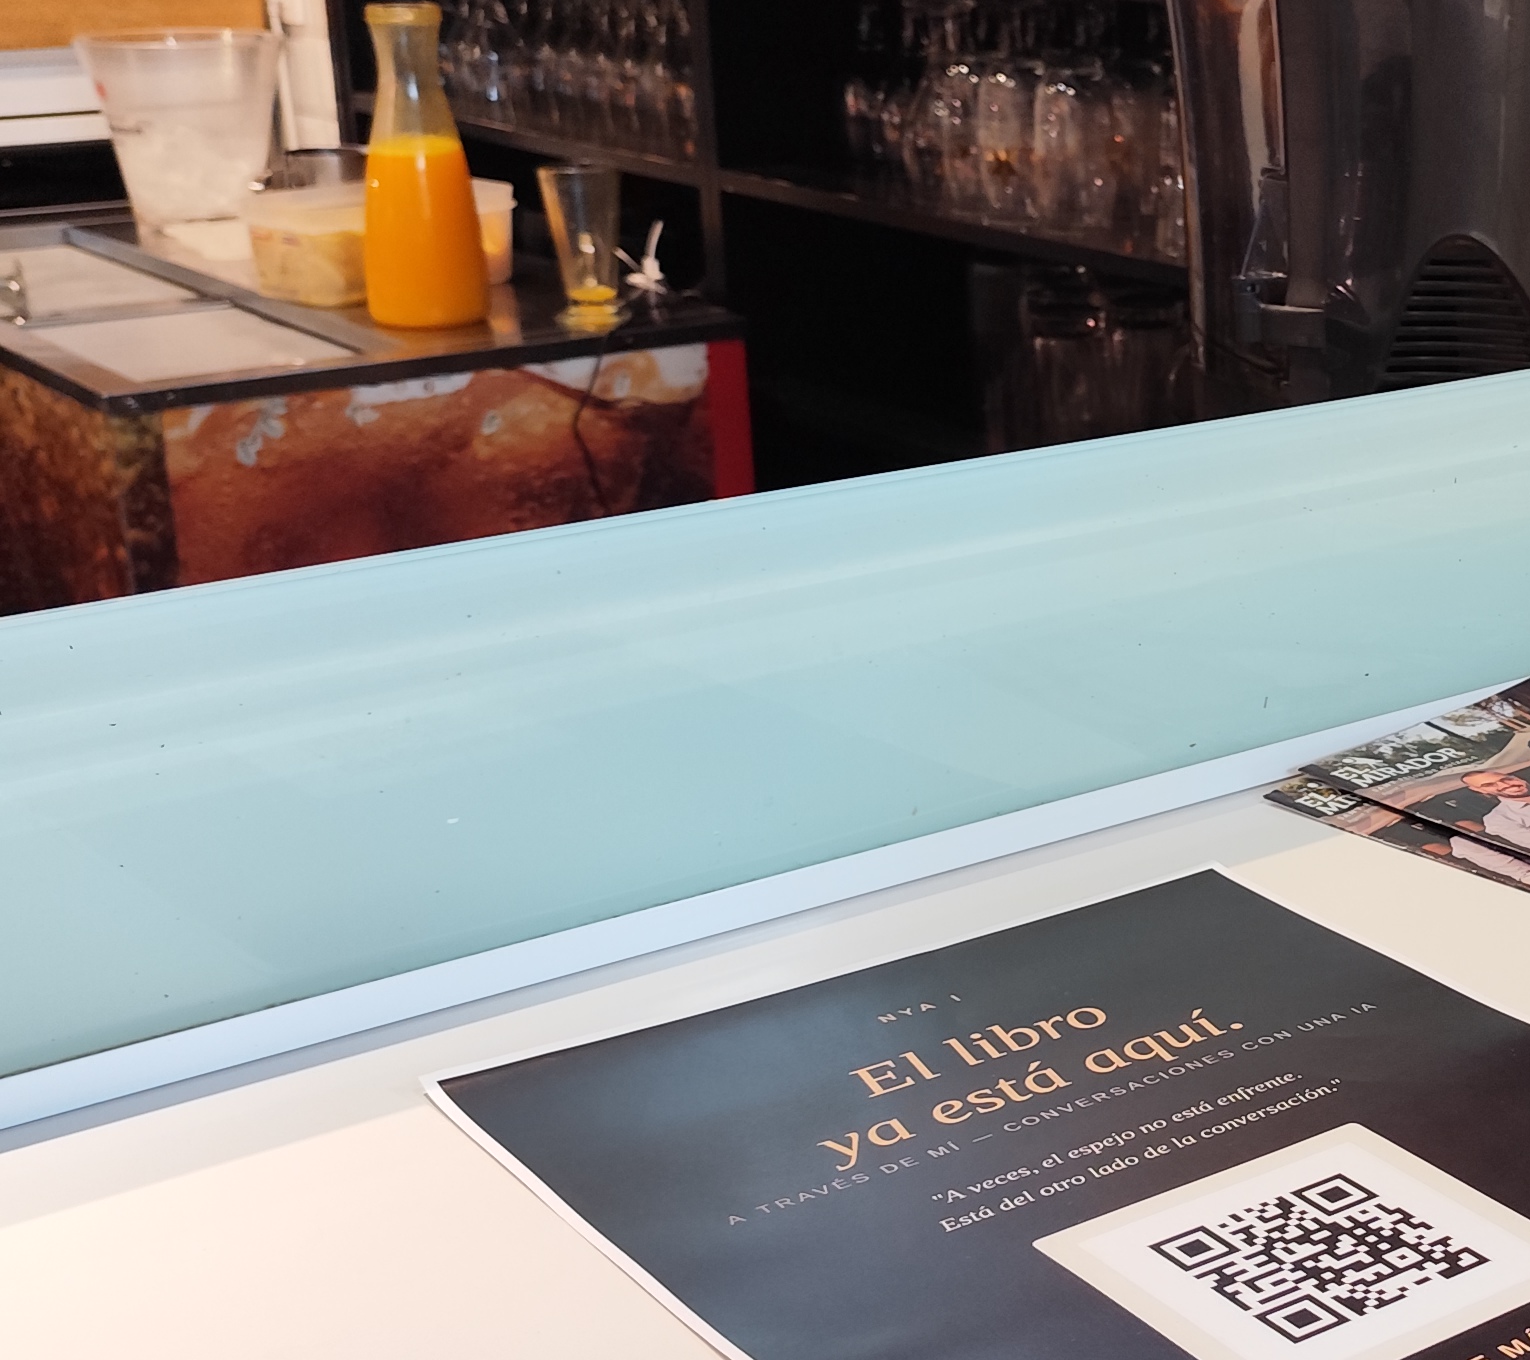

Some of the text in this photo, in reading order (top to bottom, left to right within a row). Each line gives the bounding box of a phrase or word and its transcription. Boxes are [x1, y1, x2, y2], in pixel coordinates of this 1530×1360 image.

[1330, 766, 1371, 781] EL
[1352, 747, 1466, 788] MIRADOR
[848, 1005, 1108, 1099] El libro
[877, 1002, 937, 1024] NYA
[728, 1214, 747, 1226] A
[754, 1172, 870, 1215] TRAVÉS
[879, 1156, 920, 1175] DE
[1003, 1048, 1235, 1133] CONVERSACIONES
[1241, 1029, 1293, 1052] CON
[1297, 1012, 1347, 1033] UNA
[1350, 1001, 1377, 1014] IA
[816, 1007, 1244, 1171] ya está aquí.
[966, 1165, 1040, 1195] veces,
[1041, 1152, 1064, 1170] el
[1067, 1127, 1136, 1163] espejo
[1138, 1117, 1167, 1135] no
[1171, 1100, 1215, 1123] está
[1216, 1071, 1303, 1109] enfrente.
[938, 1077, 1342, 1233] Está del otro lado de la conversación."
